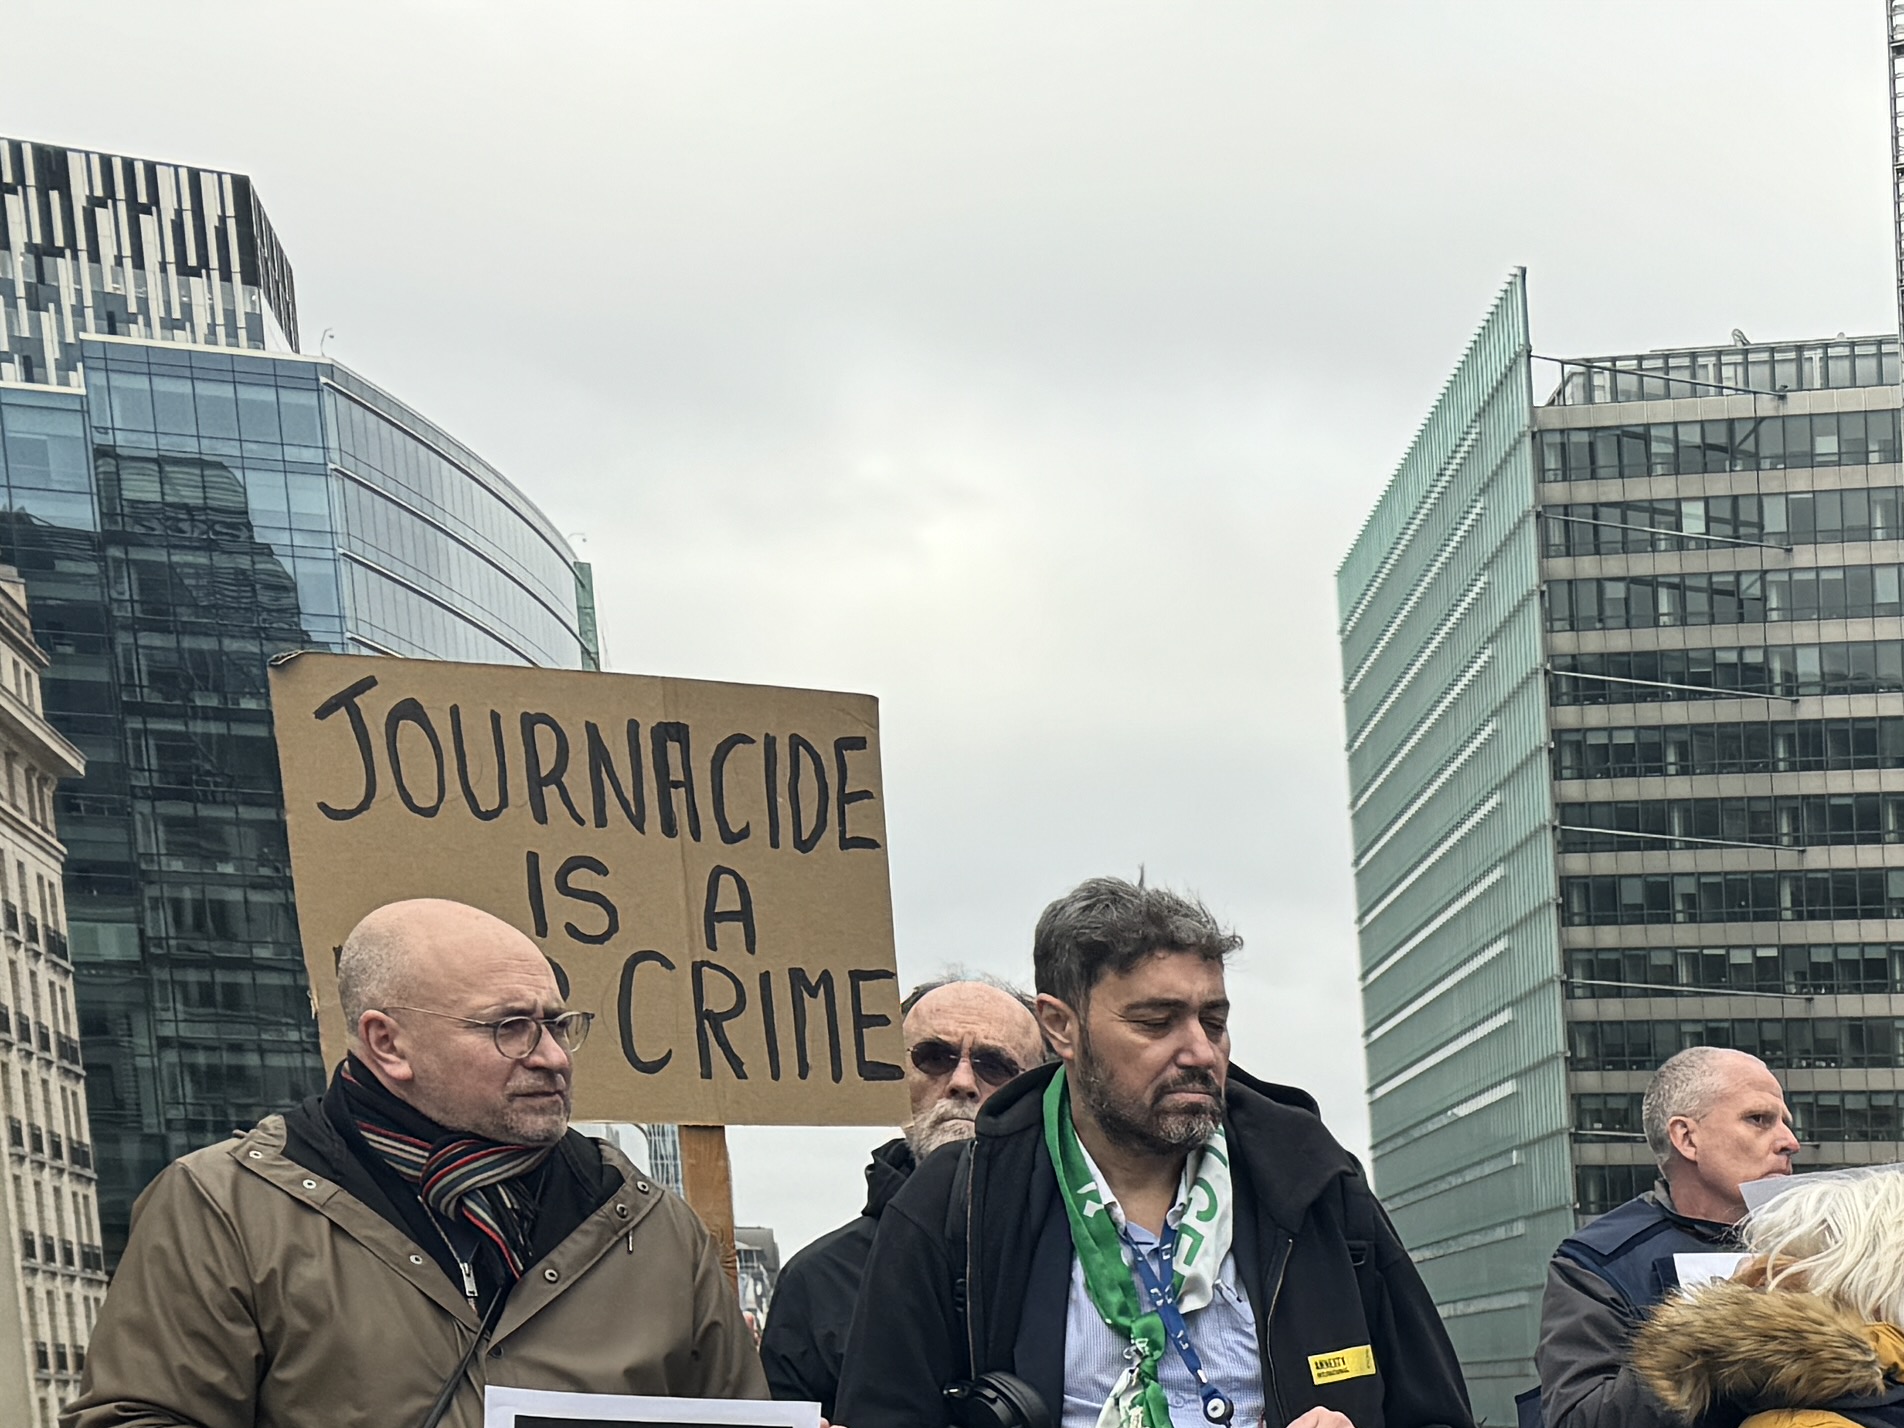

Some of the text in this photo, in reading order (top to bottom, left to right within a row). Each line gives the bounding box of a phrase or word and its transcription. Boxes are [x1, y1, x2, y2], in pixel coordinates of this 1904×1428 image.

[314, 676, 882, 852] JOURNACIDE
[526, 850, 756, 955] IS A
[619, 949, 905, 1082] CRIME
